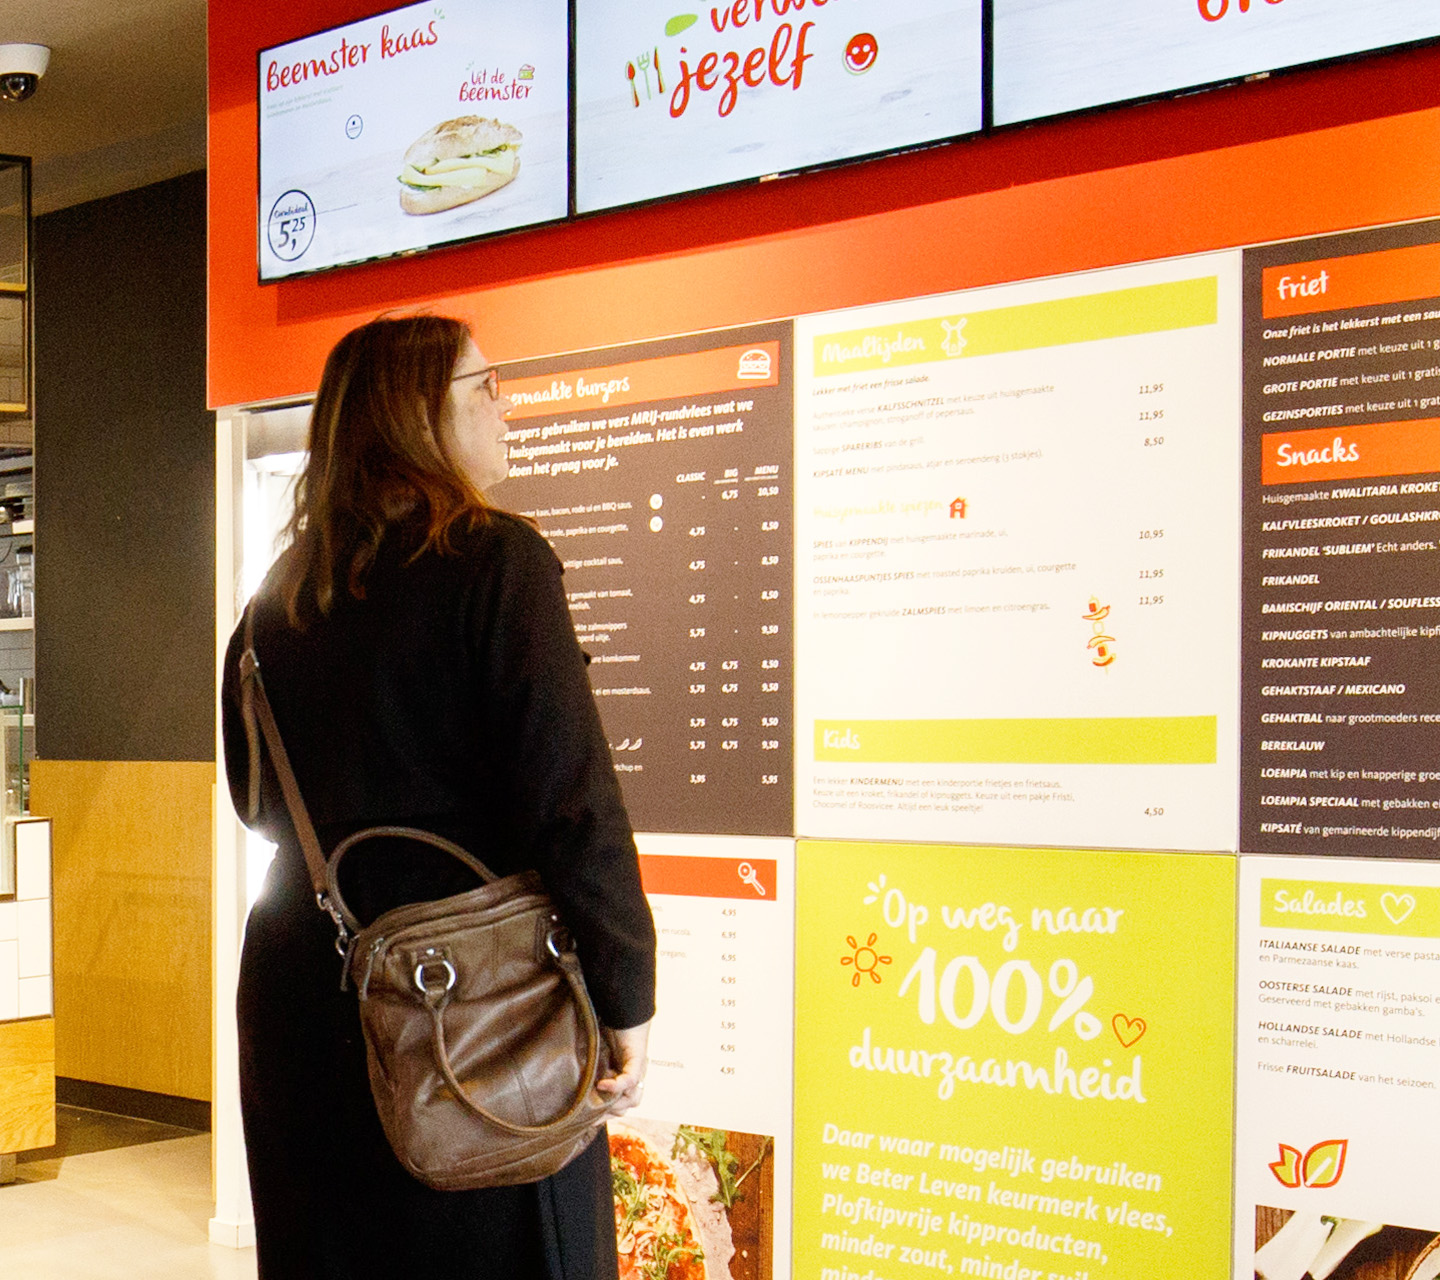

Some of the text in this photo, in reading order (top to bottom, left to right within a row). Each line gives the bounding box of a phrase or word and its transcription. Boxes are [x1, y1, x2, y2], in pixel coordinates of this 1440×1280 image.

[267, 20, 439, 92] Beemster kaas
[670, 22, 815, 118] jezelf
[459, 78, 534, 103] Beemster
[470, 67, 506, 86] Uit de
[822, 333, 926, 364] Maaltijden
[576, 377, 630, 403] burgers
[1276, 437, 1360, 468] Snacks
[676, 465, 778, 483] CLASSIC BIG MENU
[1262, 574, 1320, 587] FRIKANDEL
[1262, 655, 1370, 670] KROKANTE KIPSTAAF
[823, 729, 860, 750] Kids
[1261, 740, 1325, 752] BEREKLAUW
[1144, 806, 1164, 818] 4,50
[1273, 889, 1367, 919] Salades
[882, 888, 1123, 952] Op weg naar
[898, 946, 1102, 1041] 100%
[849, 1028, 1147, 1104] duurzaamheid
[822, 1123, 1162, 1193] Daar waar mogelijk gebruiken
[822, 1164, 1174, 1238] we Beter Leven keurmerk vlees,
[822, 1193, 1109, 1265] Plofkipvrije kipproducten,
[821, 1230, 894, 1262] minder
[900, 1243, 955, 1274] zout,
